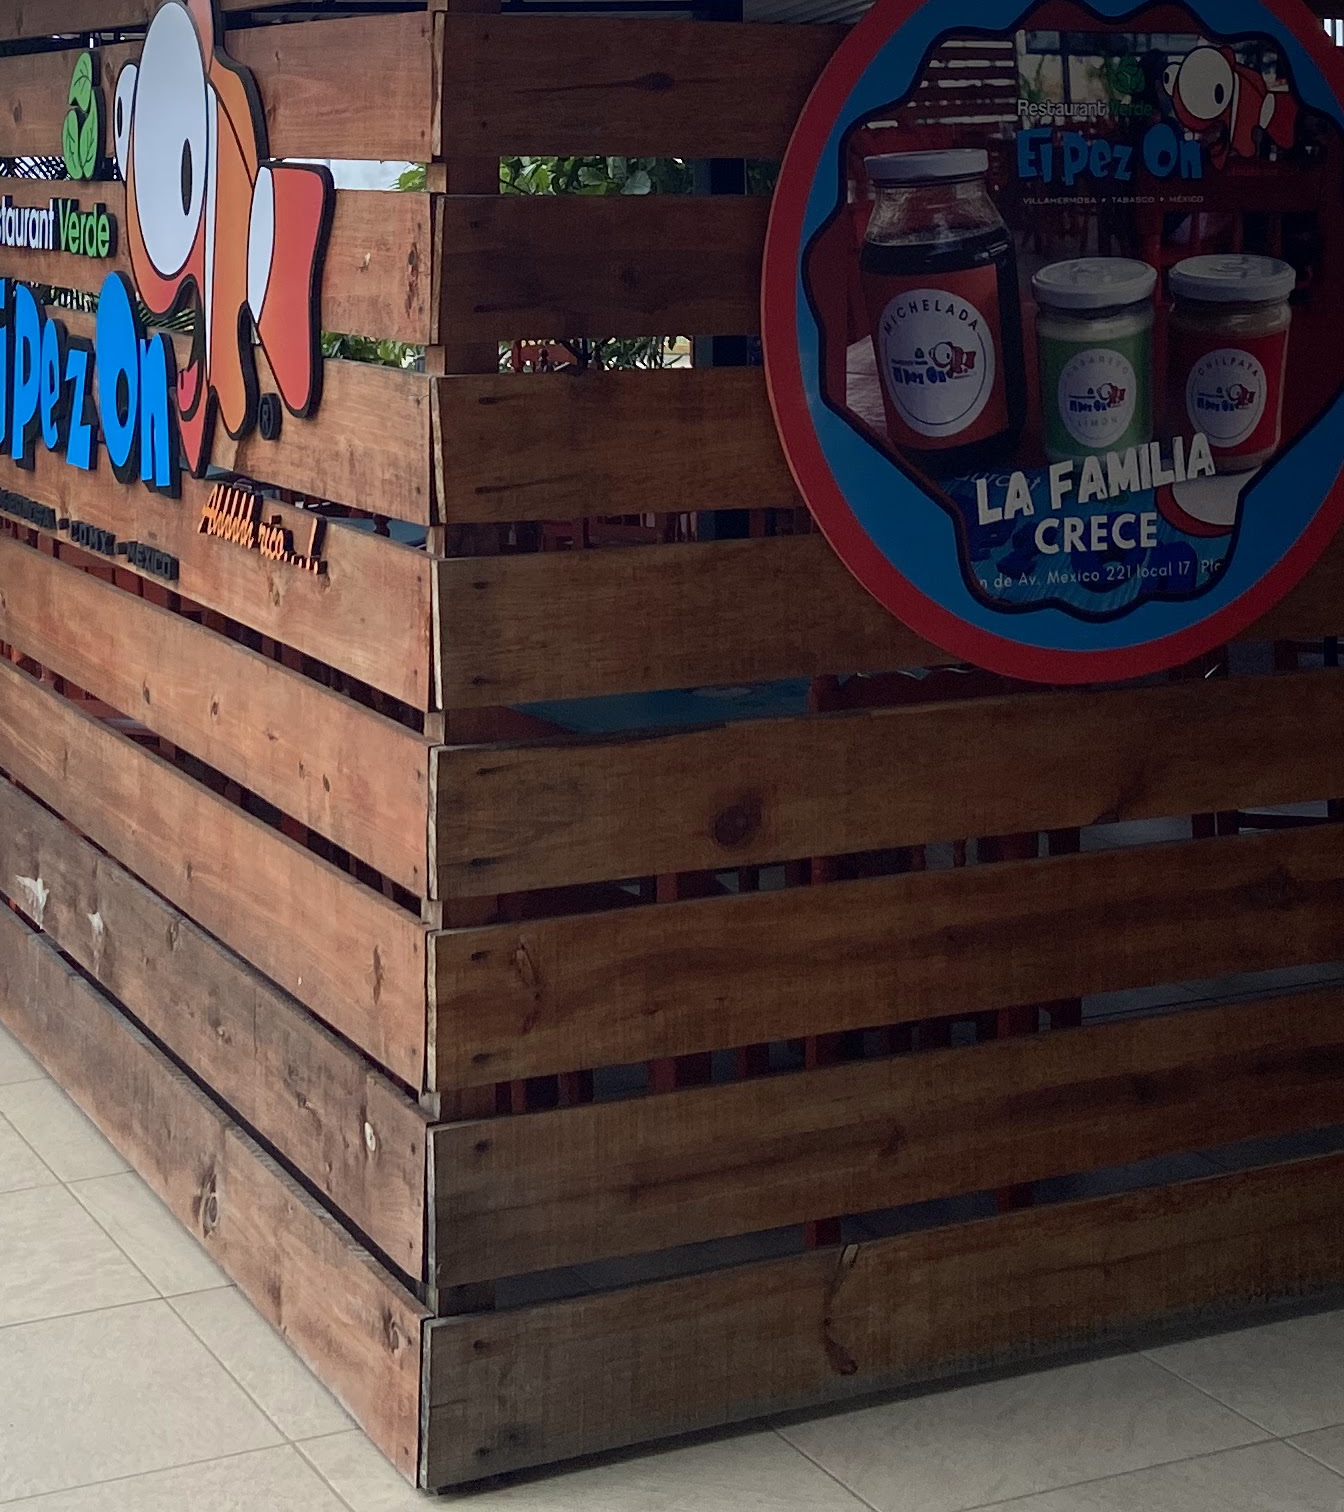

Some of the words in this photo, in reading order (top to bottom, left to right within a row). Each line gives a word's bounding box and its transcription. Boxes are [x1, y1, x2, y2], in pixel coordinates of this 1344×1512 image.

[1017, 98, 1106, 117] Restaurant
[1063, 130, 1133, 187] Pez
[1143, 123, 1203, 180] On
[1022, 195, 1097, 205] VILLAHERMOSA
[1111, 195, 1155, 204] TABASCO
[57, 197, 112, 258] Verde
[884, 300, 977, 335] MICHELADA
[96, 270, 171, 488] On
[975, 471, 1035, 526] LA
[1049, 432, 1216, 510] FAMILIA
[1035, 512, 1158, 555] CRECE
[994, 572, 1012, 588] de
[1106, 564, 1131, 581] 221
[1137, 562, 1172, 578] local
[1178, 560, 1191, 575] 17
